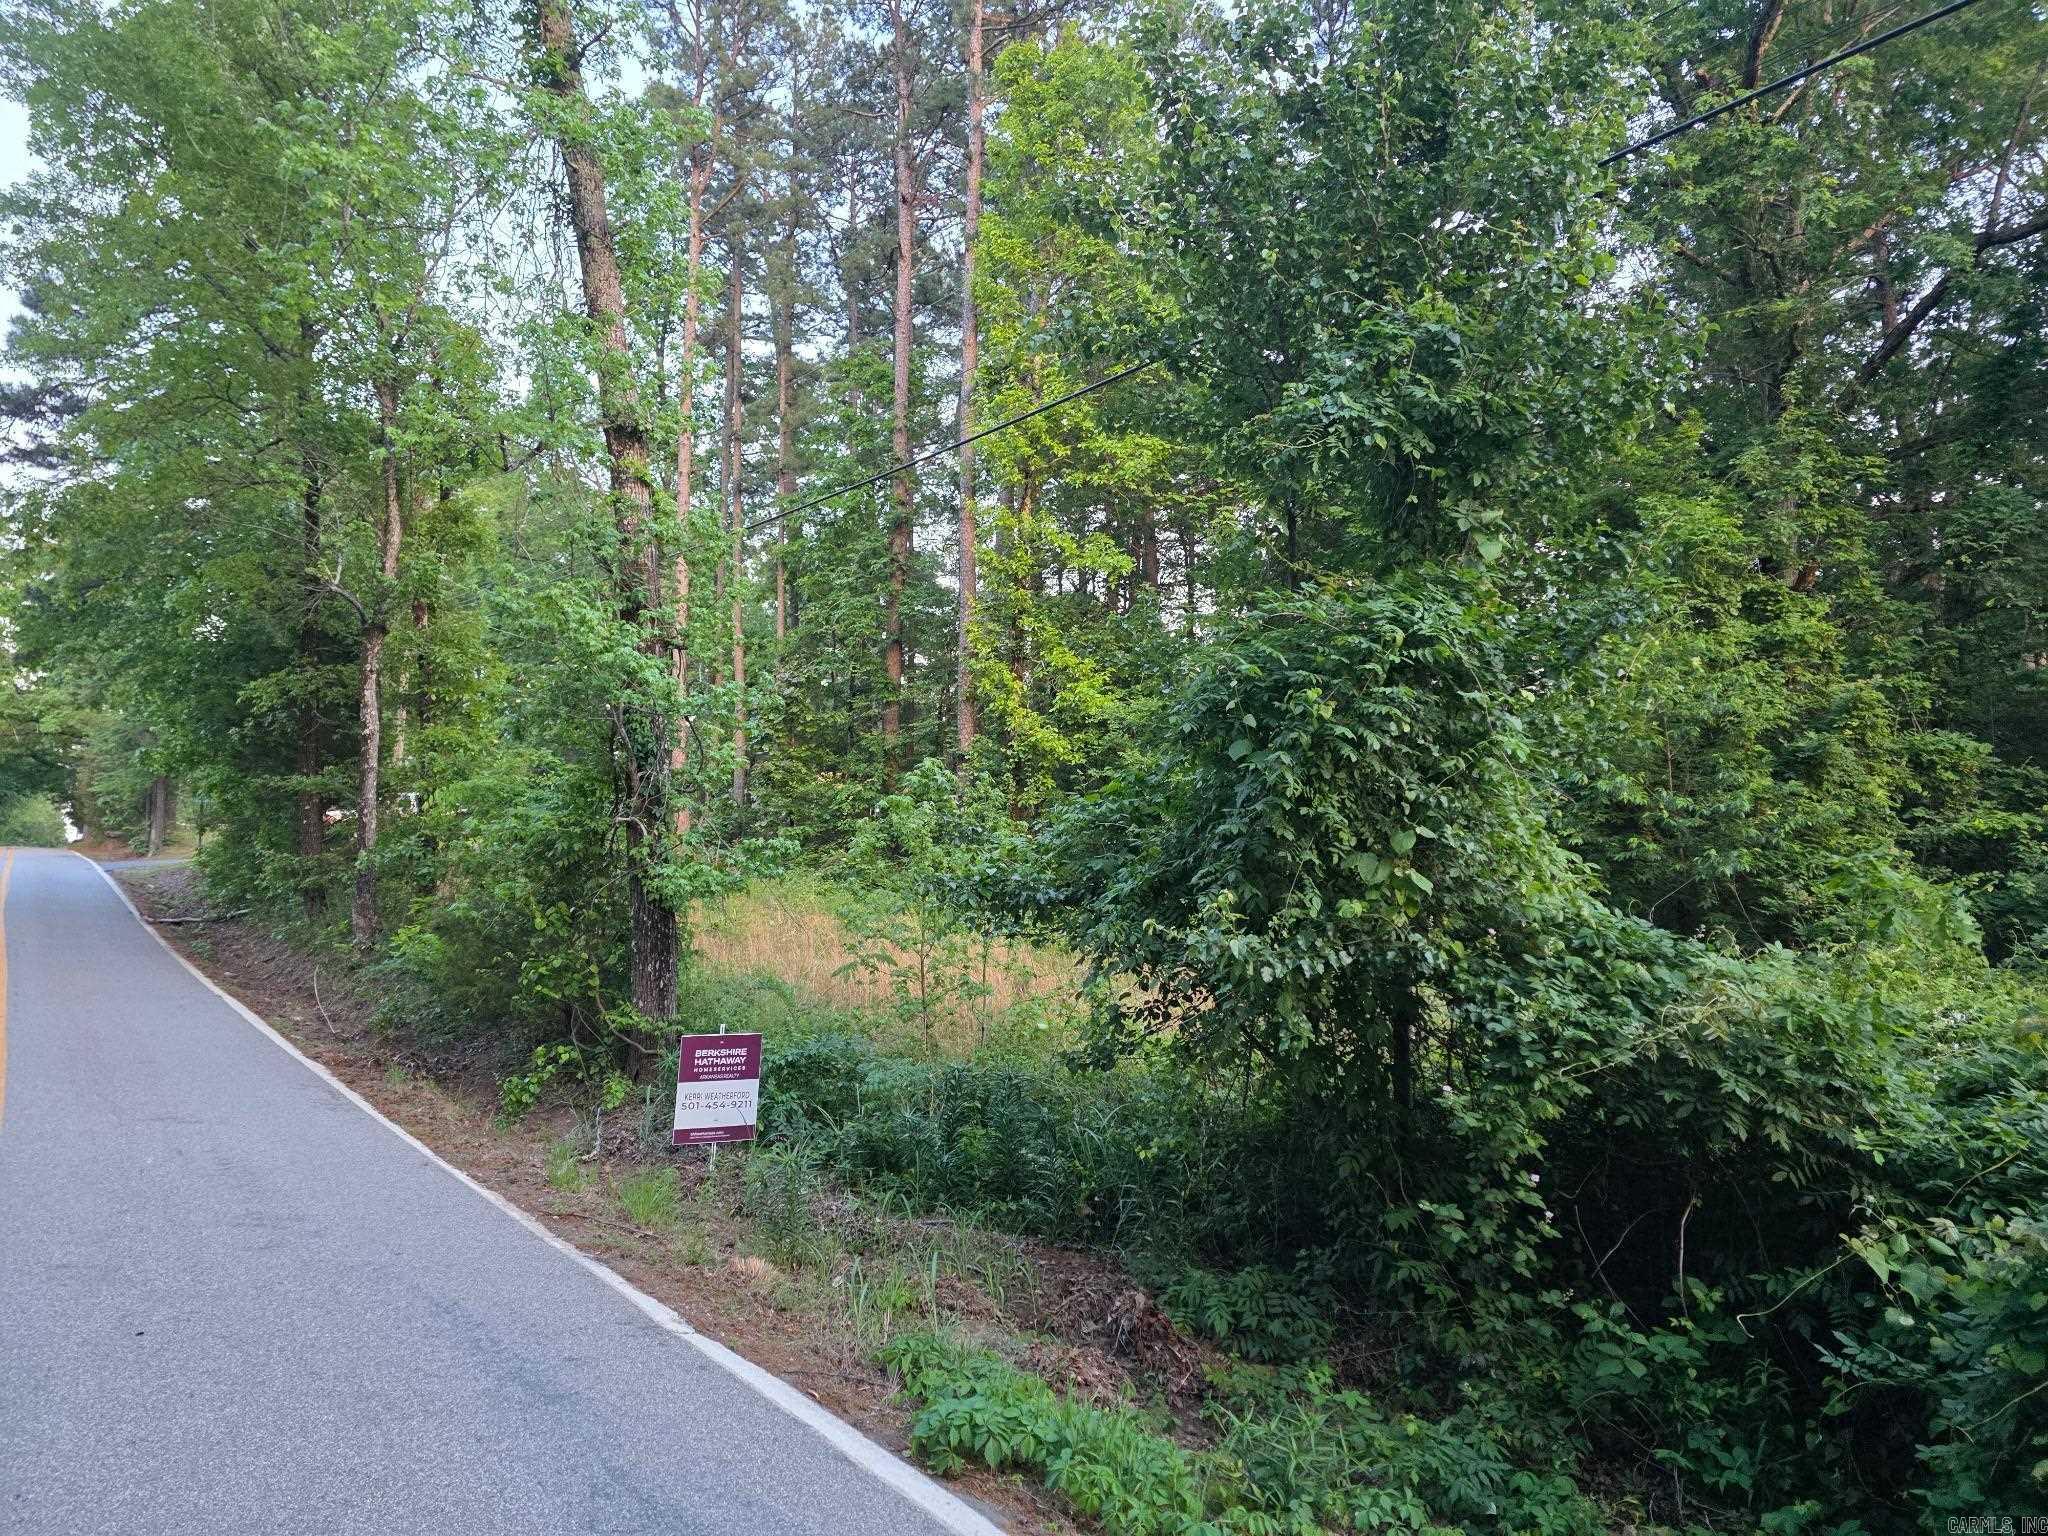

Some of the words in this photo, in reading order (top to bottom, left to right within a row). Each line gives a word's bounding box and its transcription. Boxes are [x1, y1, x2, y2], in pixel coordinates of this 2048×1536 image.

[695, 1048, 748, 1057] BERKSHIRE
[694, 1057, 747, 1066] HATHAWAY
[681, 1100, 752, 1110] 501-454-9211
